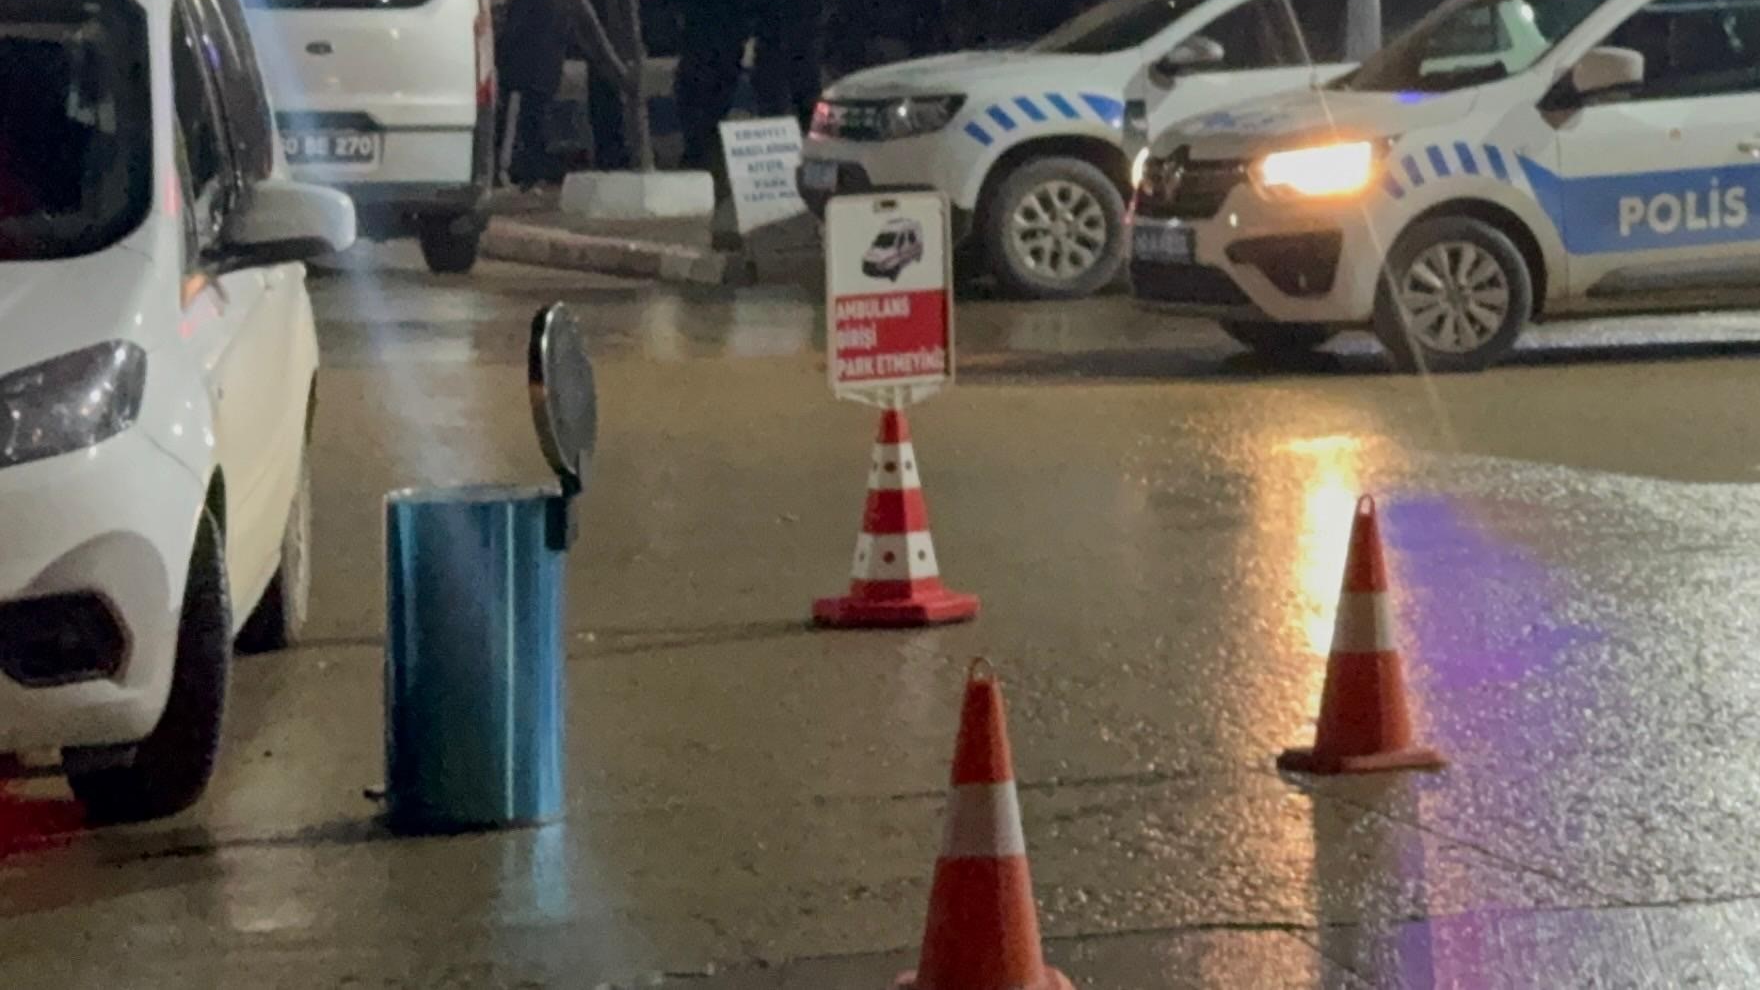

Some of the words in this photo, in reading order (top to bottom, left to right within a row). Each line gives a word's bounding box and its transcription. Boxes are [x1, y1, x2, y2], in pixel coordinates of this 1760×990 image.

[1618, 176, 1748, 237] POLİS
[836, 295, 910, 321] AMBULANS
[836, 355, 875, 380] PARK
